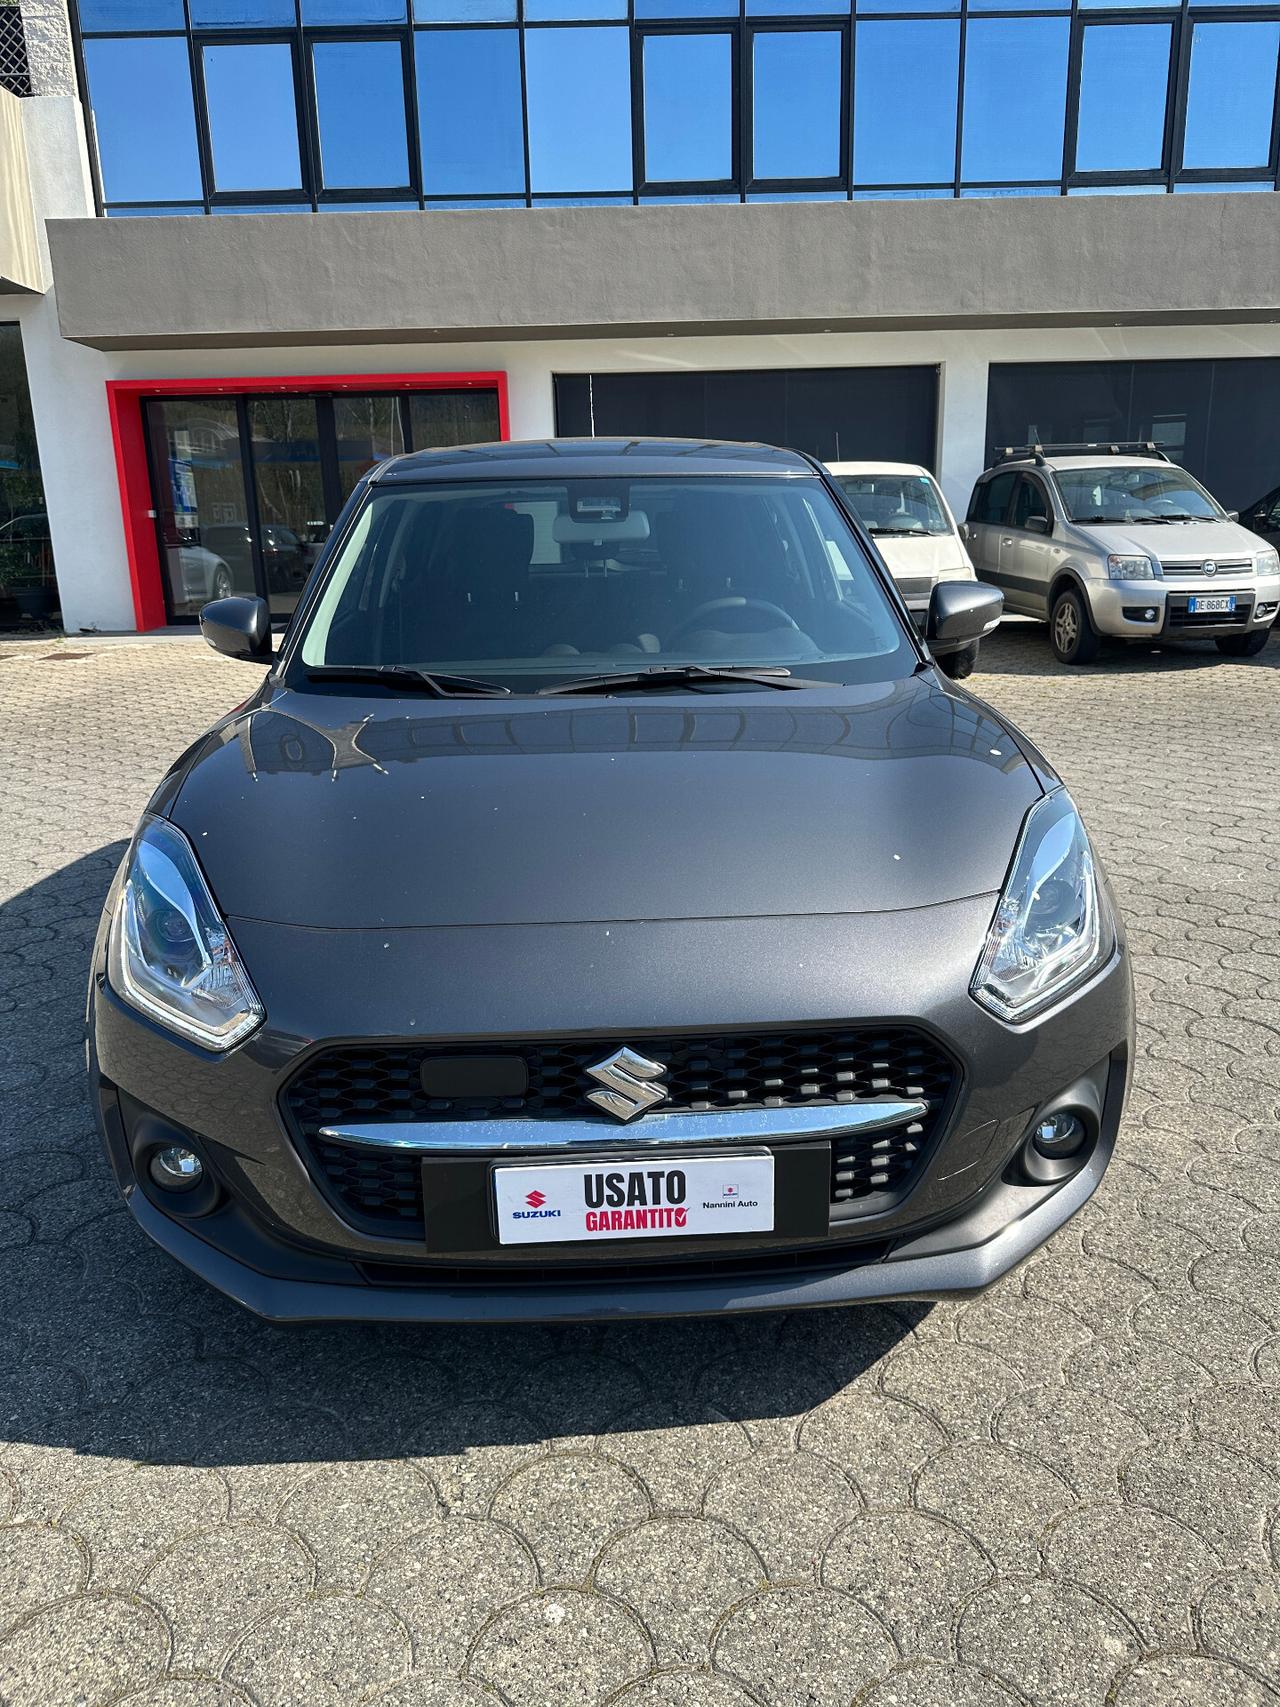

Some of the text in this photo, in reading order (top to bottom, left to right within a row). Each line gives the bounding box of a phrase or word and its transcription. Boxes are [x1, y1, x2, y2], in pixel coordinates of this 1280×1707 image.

[1196, 600, 1205, 610] DE
[583, 1169, 686, 1209] USATO
[702, 1200, 758, 1209] Nannini Auto
[512, 1209, 561, 1220] SUZUKI
[585, 1207, 689, 1232] GARANTITO
